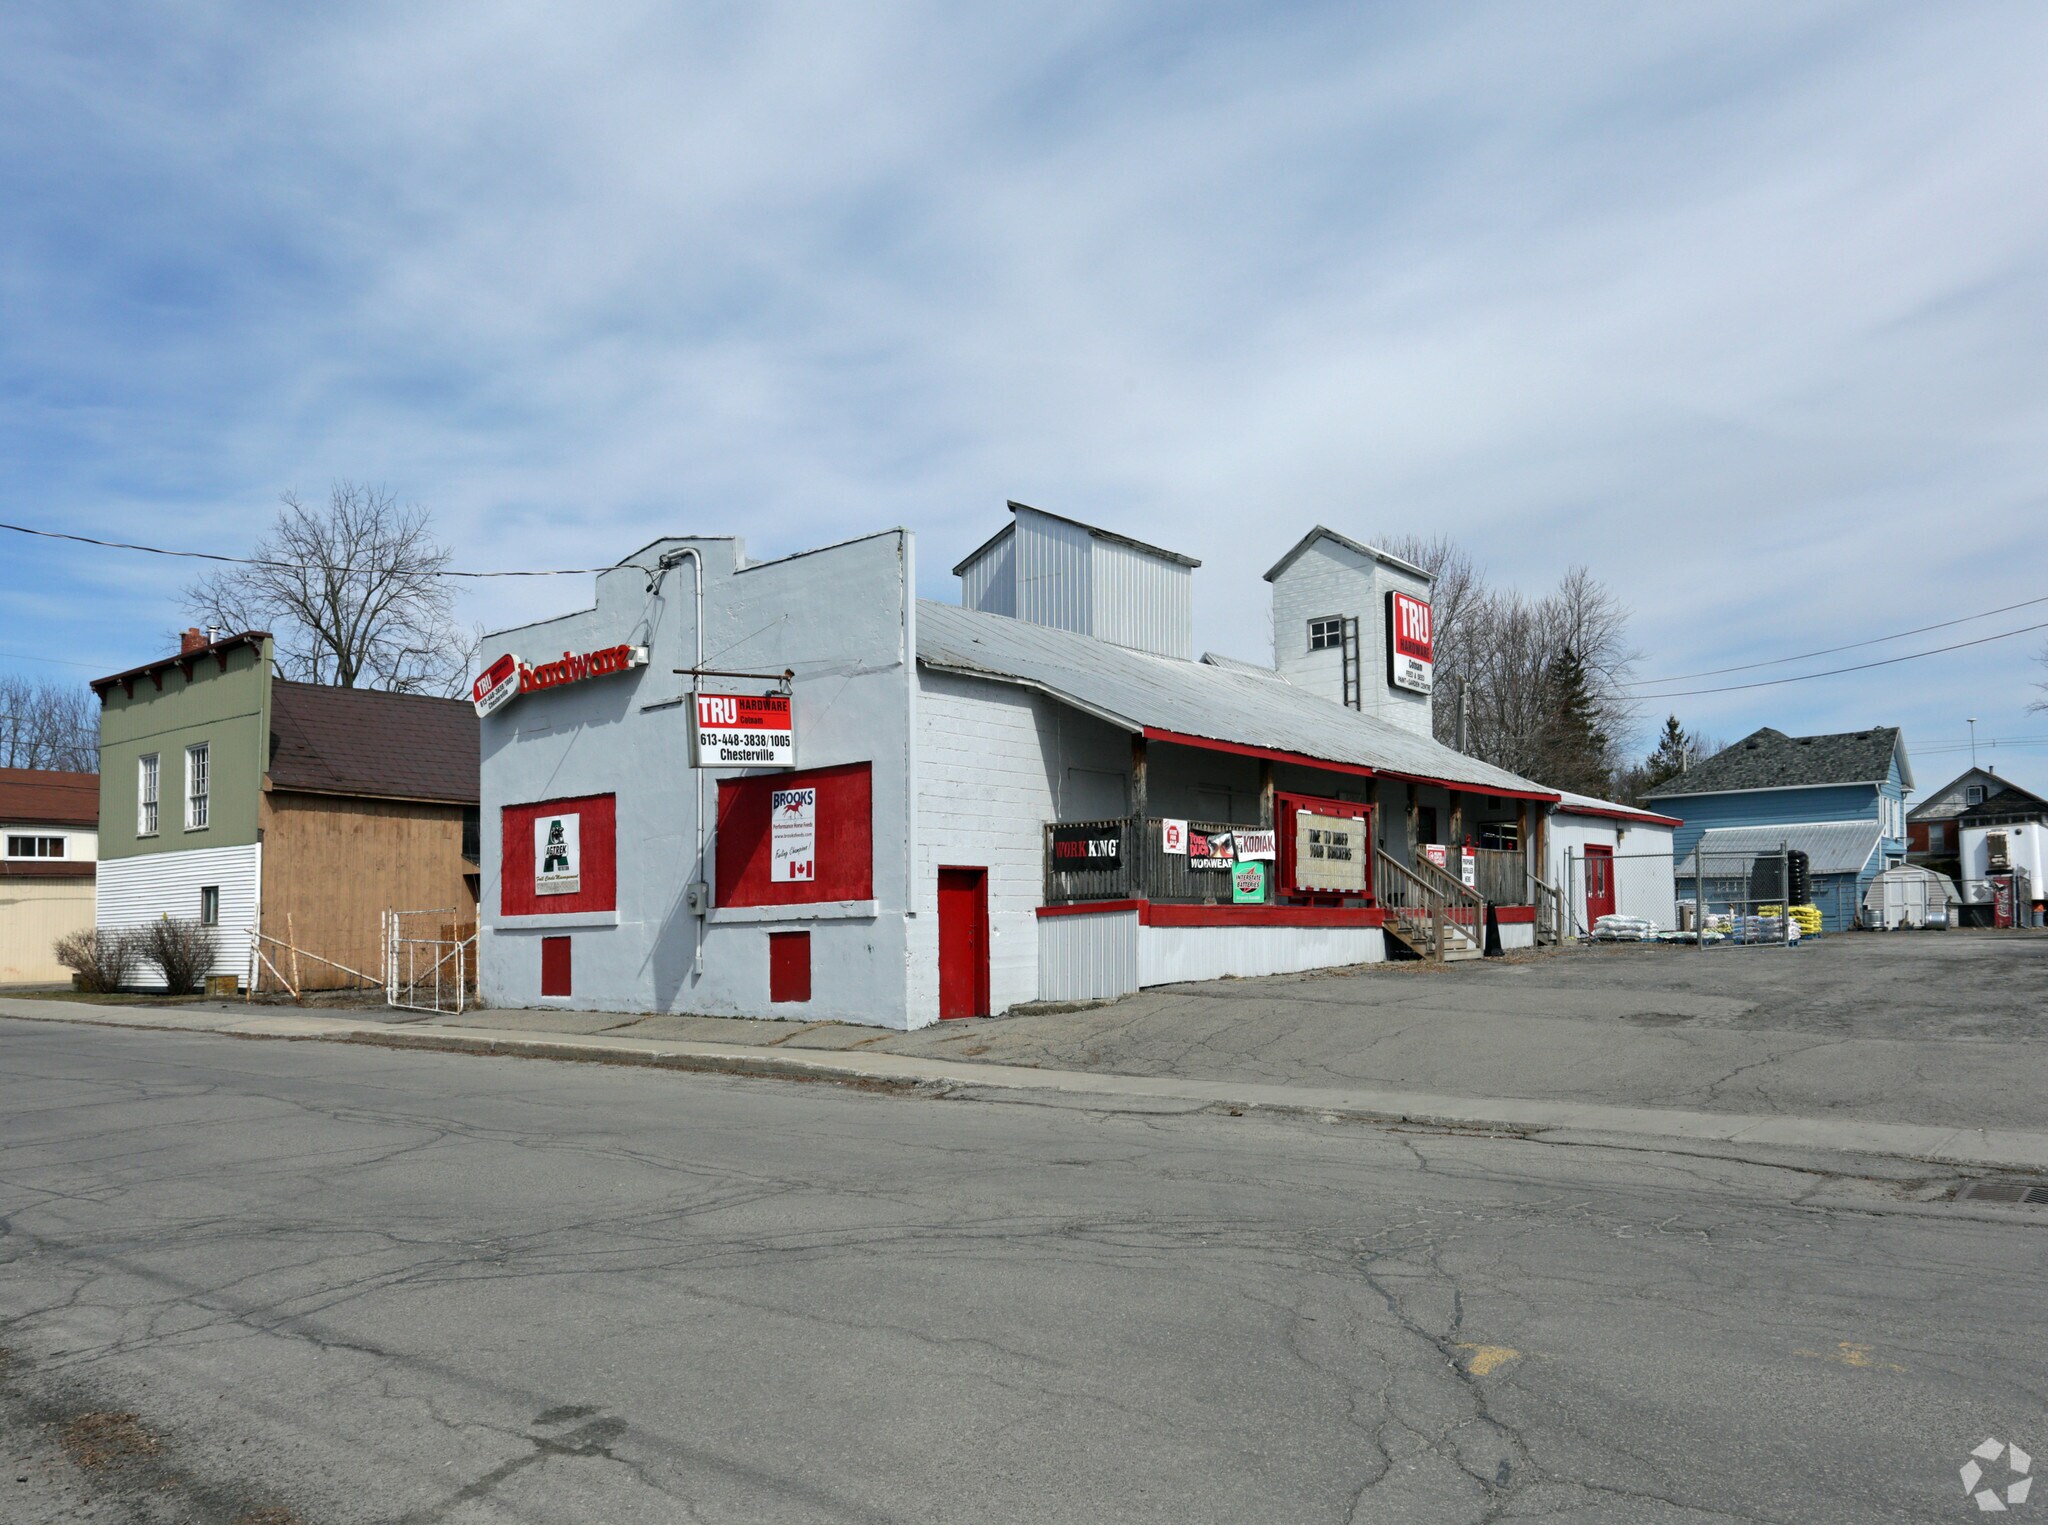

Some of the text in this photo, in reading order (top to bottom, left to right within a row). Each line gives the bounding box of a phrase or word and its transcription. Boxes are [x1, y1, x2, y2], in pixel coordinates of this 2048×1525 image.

[1399, 597, 1429, 644] TRU
[1400, 638, 1430, 659] HARDWARE
[518, 644, 632, 693] hardware
[476, 673, 493, 697] TRU
[698, 697, 788, 724] TRU HARDWARE
[700, 733, 791, 748] 613-448-3838/1005
[720, 748, 774, 761] Chesterville
[773, 790, 813, 810] BROOKS
[546, 845, 567, 855] AGTREK
[1055, 839, 1117, 858] WORK KING
[1243, 835, 1276, 853] KODIAK
